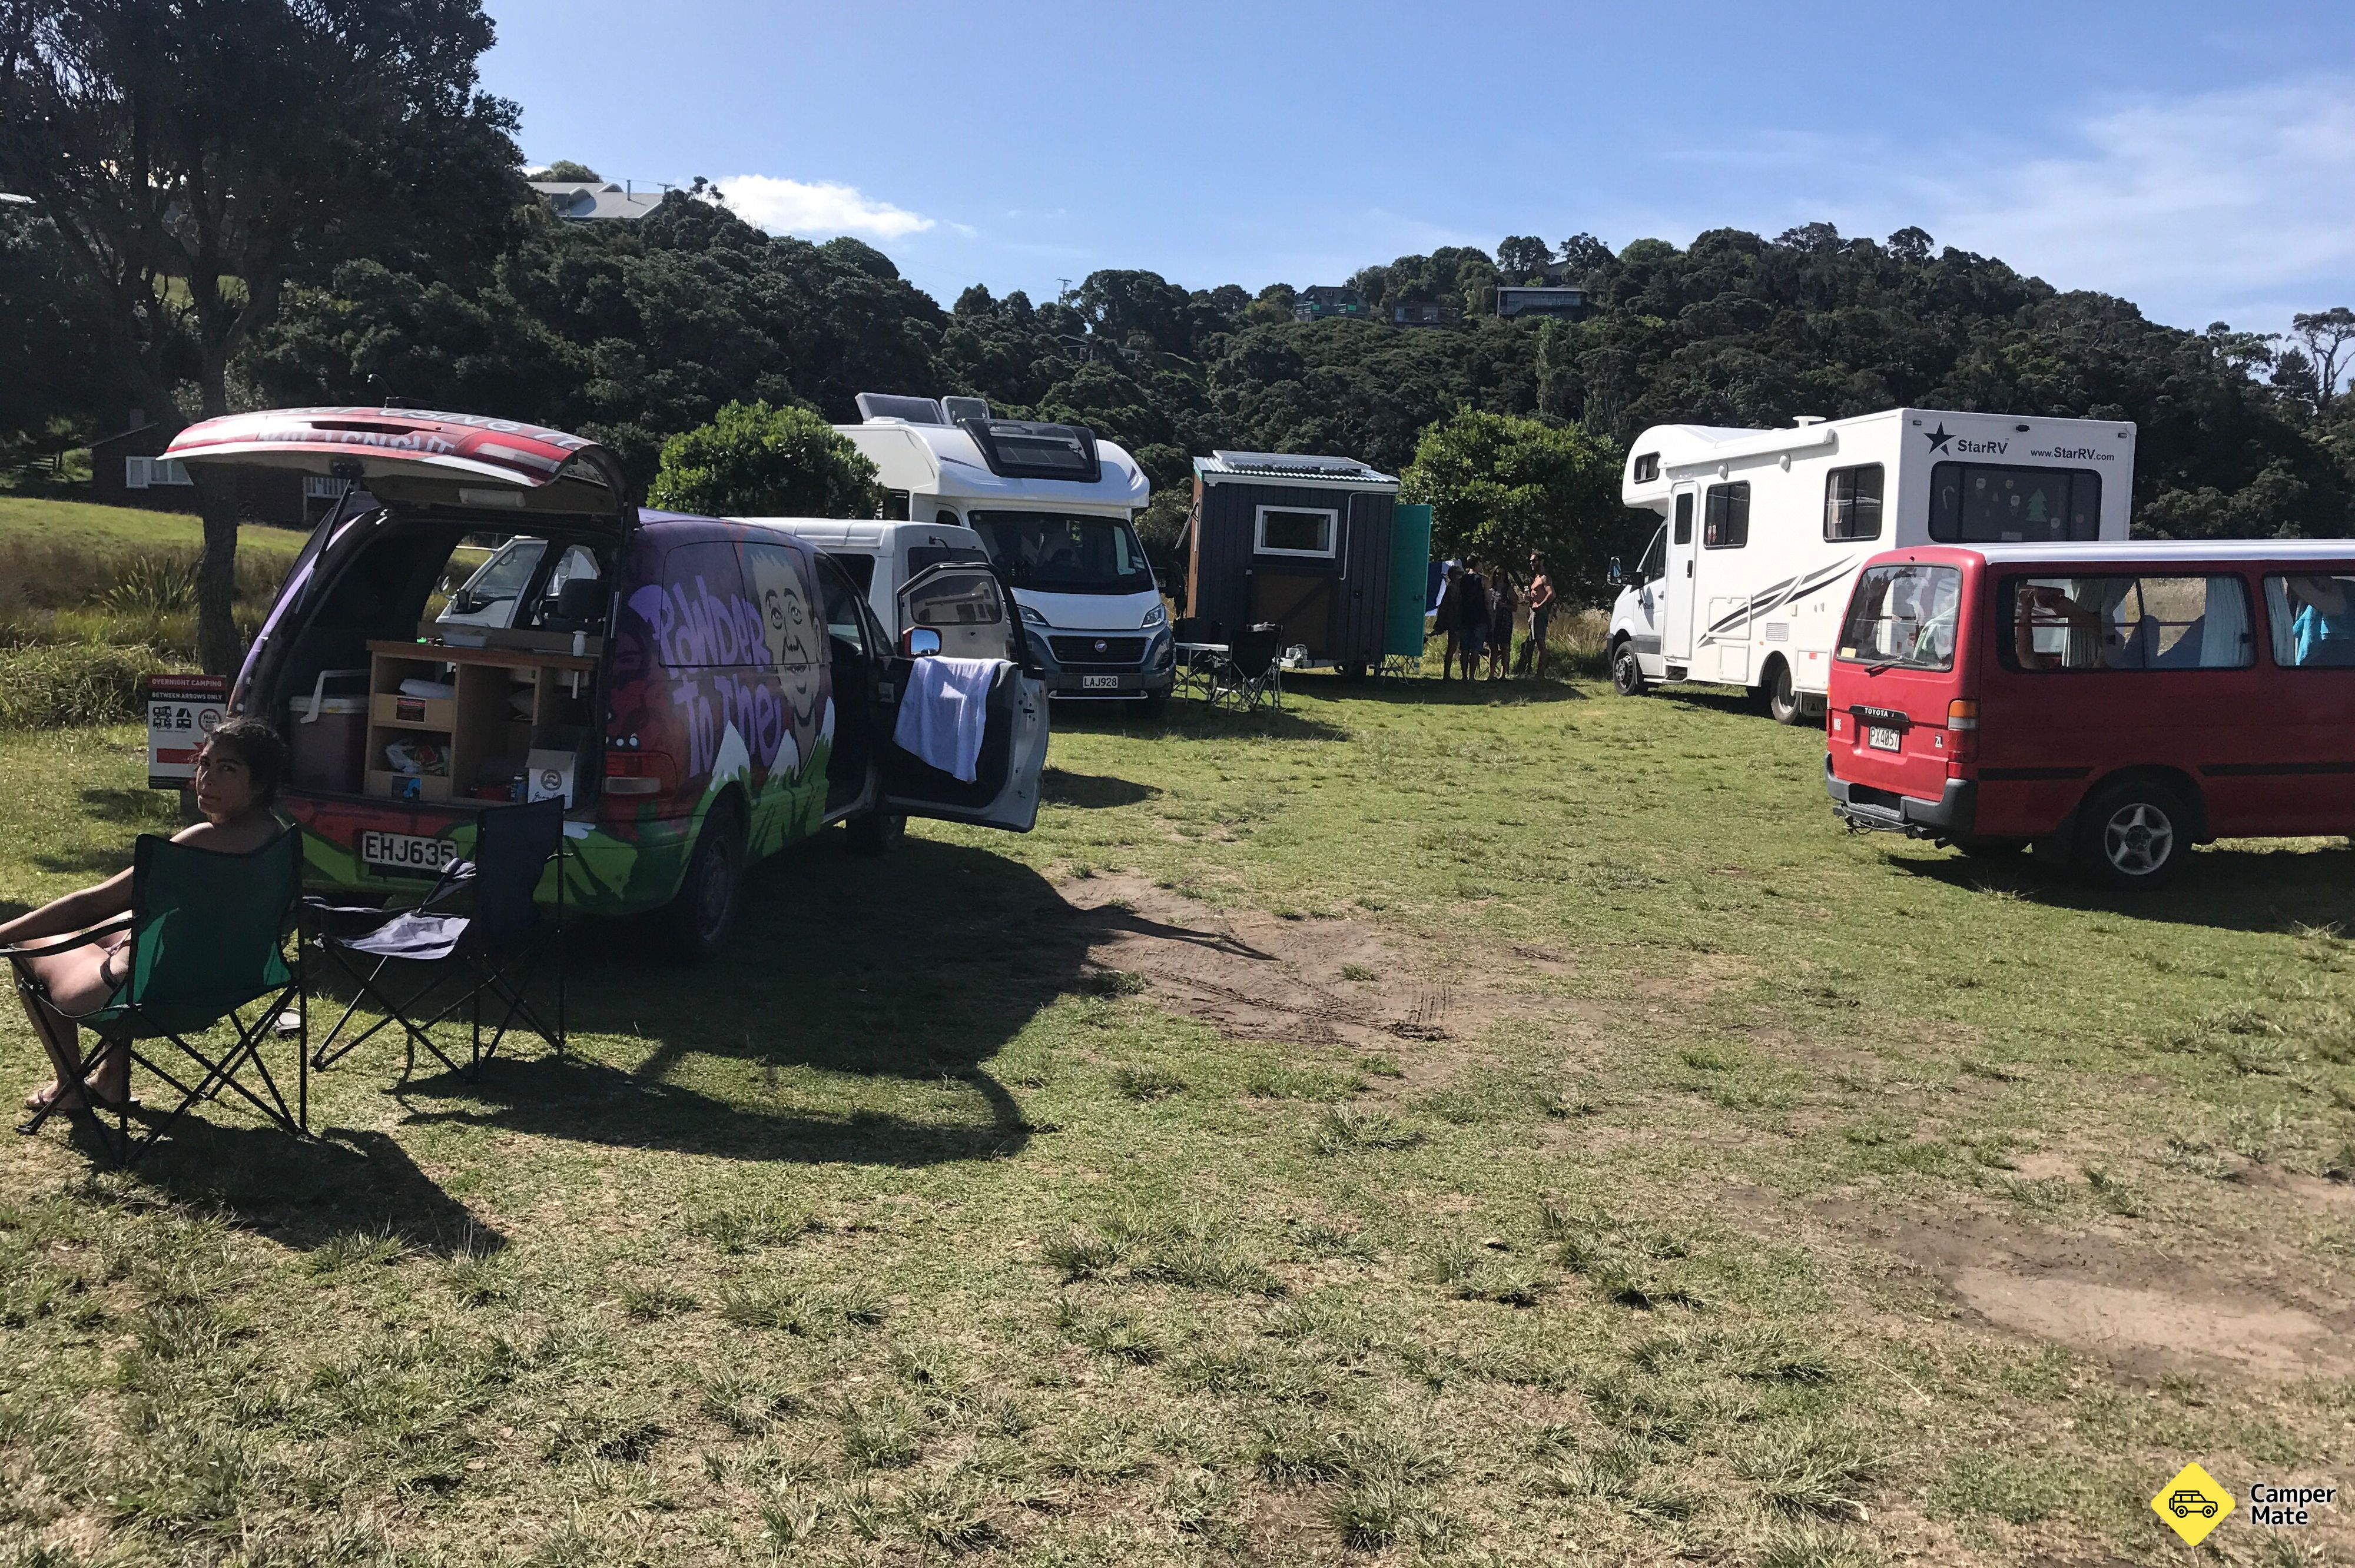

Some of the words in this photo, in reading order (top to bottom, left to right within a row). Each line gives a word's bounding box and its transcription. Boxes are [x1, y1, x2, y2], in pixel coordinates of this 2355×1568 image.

[1958, 439, 2008, 454] StarRV
[2031, 447, 2114, 461] www.StarRV.com
[1084, 677, 1117, 687] LAJ928
[1865, 707, 1888, 717] TOYOTA
[366, 835, 453, 866] EHJ635
